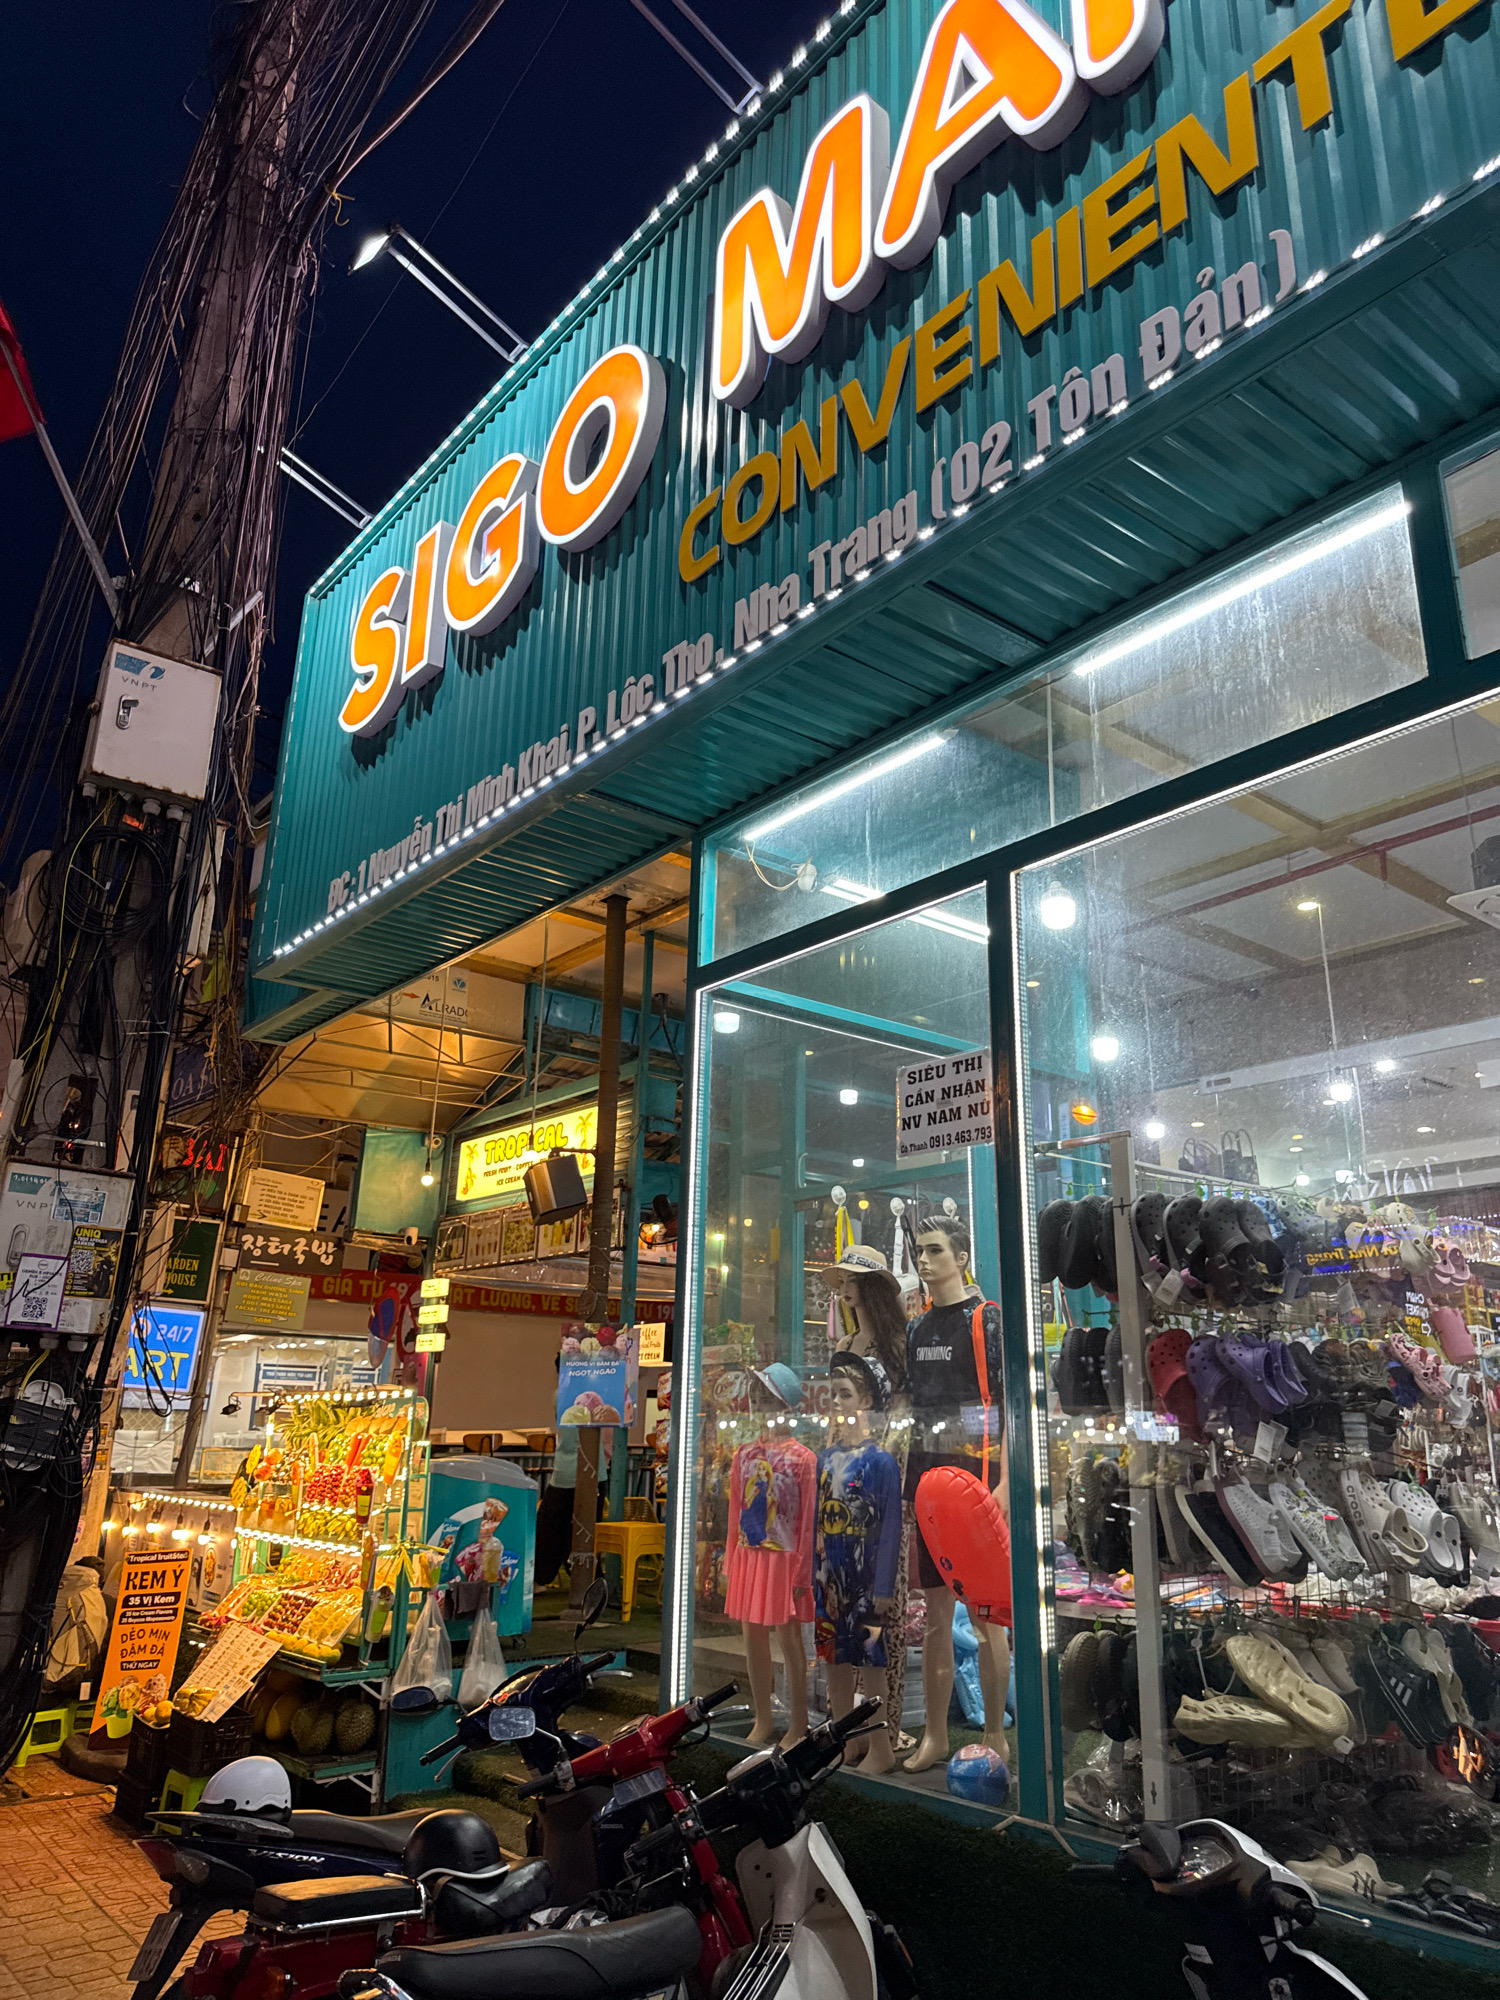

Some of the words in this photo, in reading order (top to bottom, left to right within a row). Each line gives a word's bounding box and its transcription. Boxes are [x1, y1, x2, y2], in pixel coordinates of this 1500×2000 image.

[338, 345, 664, 738] SIGO
[367, 814, 433, 889] Nguyễn
[465, 763, 515, 827] Minh
[734, 573, 800, 650] Nha
[808, 490, 918, 598] Trang
[1027, 353, 1128, 454] Tôn
[121, 675, 157, 692] VNPT
[907, 1063, 946, 1085] SIÊU
[952, 1055, 983, 1074] THỊ
[905, 1087, 935, 1108] CẦN
[941, 1078, 986, 1101] NHẬN
[901, 1114, 922, 1131] NV
[927, 1106, 962, 1126] NAM
[484, 1122, 569, 1165] TROPCAL
[929, 1125, 993, 1149] 0913.463.793
[17, 1199, 53, 1210] VNP
[241, 1233, 338, 1266] 장터국밥
[166, 1257, 199, 1271] ARDEN
[156, 1324, 193, 1344] 24/7
[126, 1347, 190, 1381] ART
[125, 1569, 167, 1591] KEM
[172, 1564, 185, 1588] Ý
[128, 1596, 140, 1605] 35
[142, 1596, 152, 1607] Vị
[154, 1595, 175, 1604] Kem
[137, 1661, 159, 1669] NGAY
